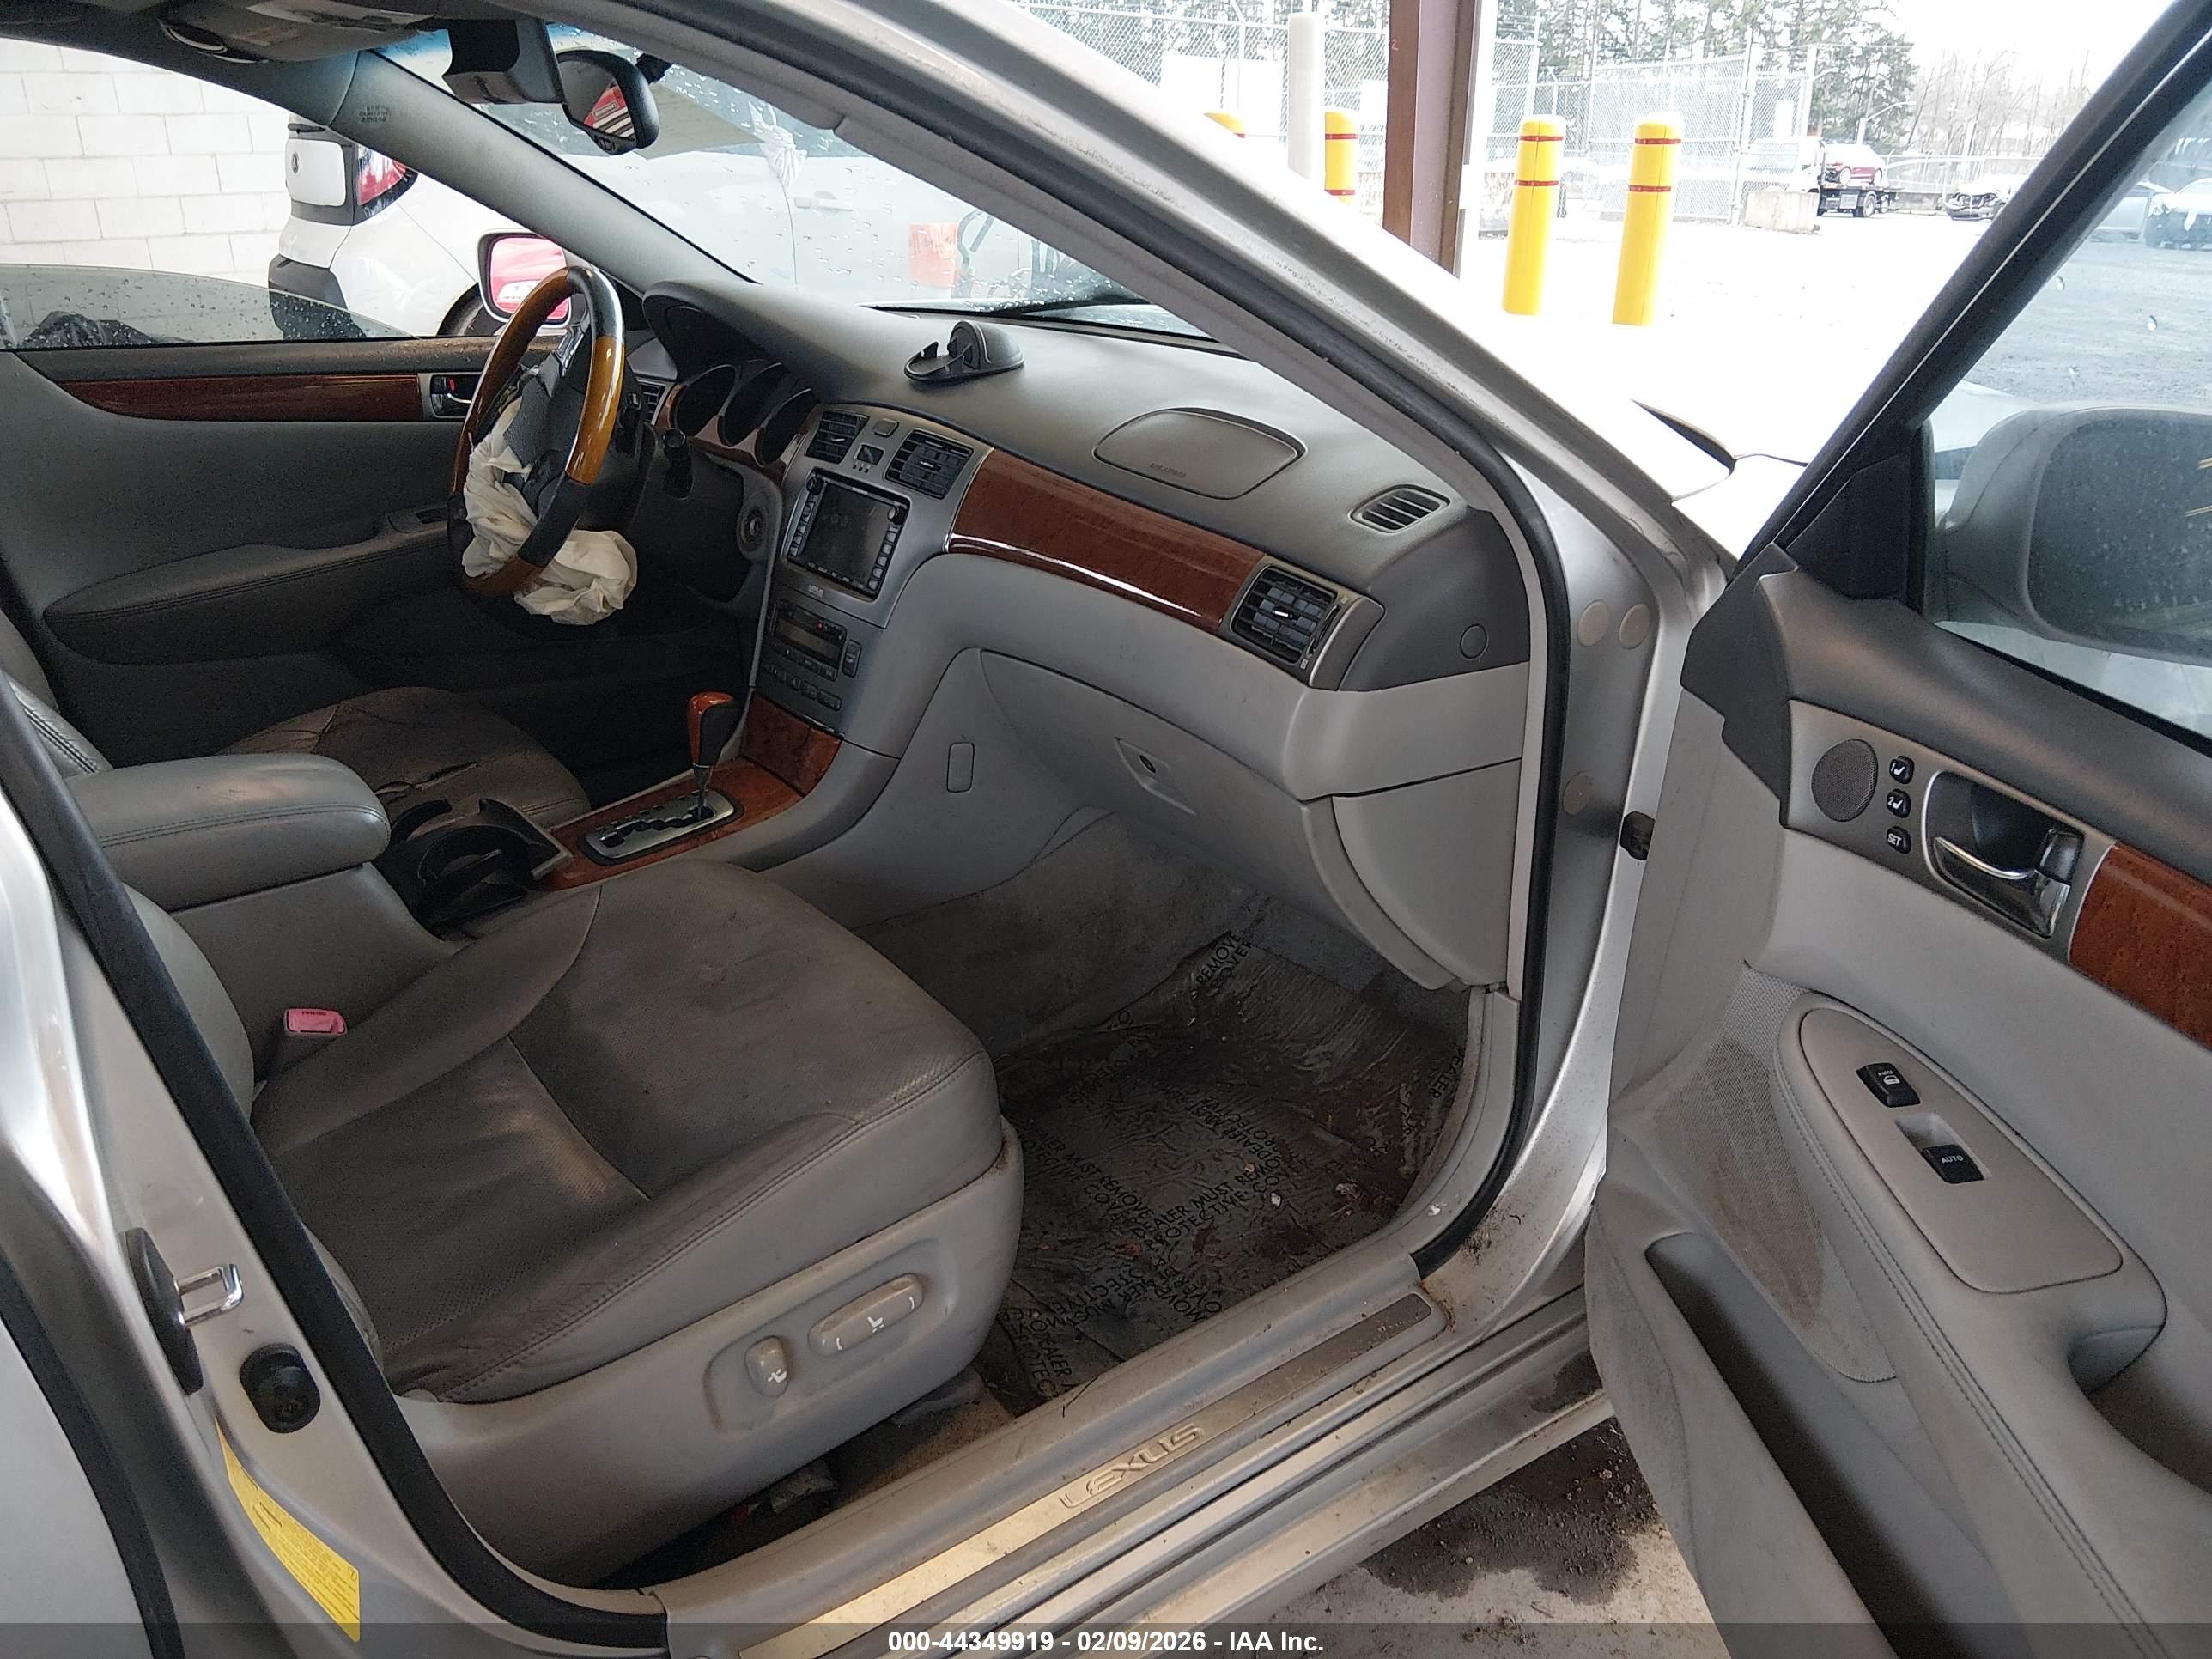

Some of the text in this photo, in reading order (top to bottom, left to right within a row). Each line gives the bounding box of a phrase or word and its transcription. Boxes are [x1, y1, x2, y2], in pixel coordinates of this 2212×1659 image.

[1887, 796, 1894, 805] 2
[1887, 833, 1902, 847] SET
[1942, 1154, 1965, 1164] AUTO
[1133, 1206, 1190, 1238] DEALER
[1190, 1181, 1235, 1208] MUST
[1144, 1190, 1250, 1249] PROTECTIVE
[1059, 1423, 1204, 1509] LEXUS
